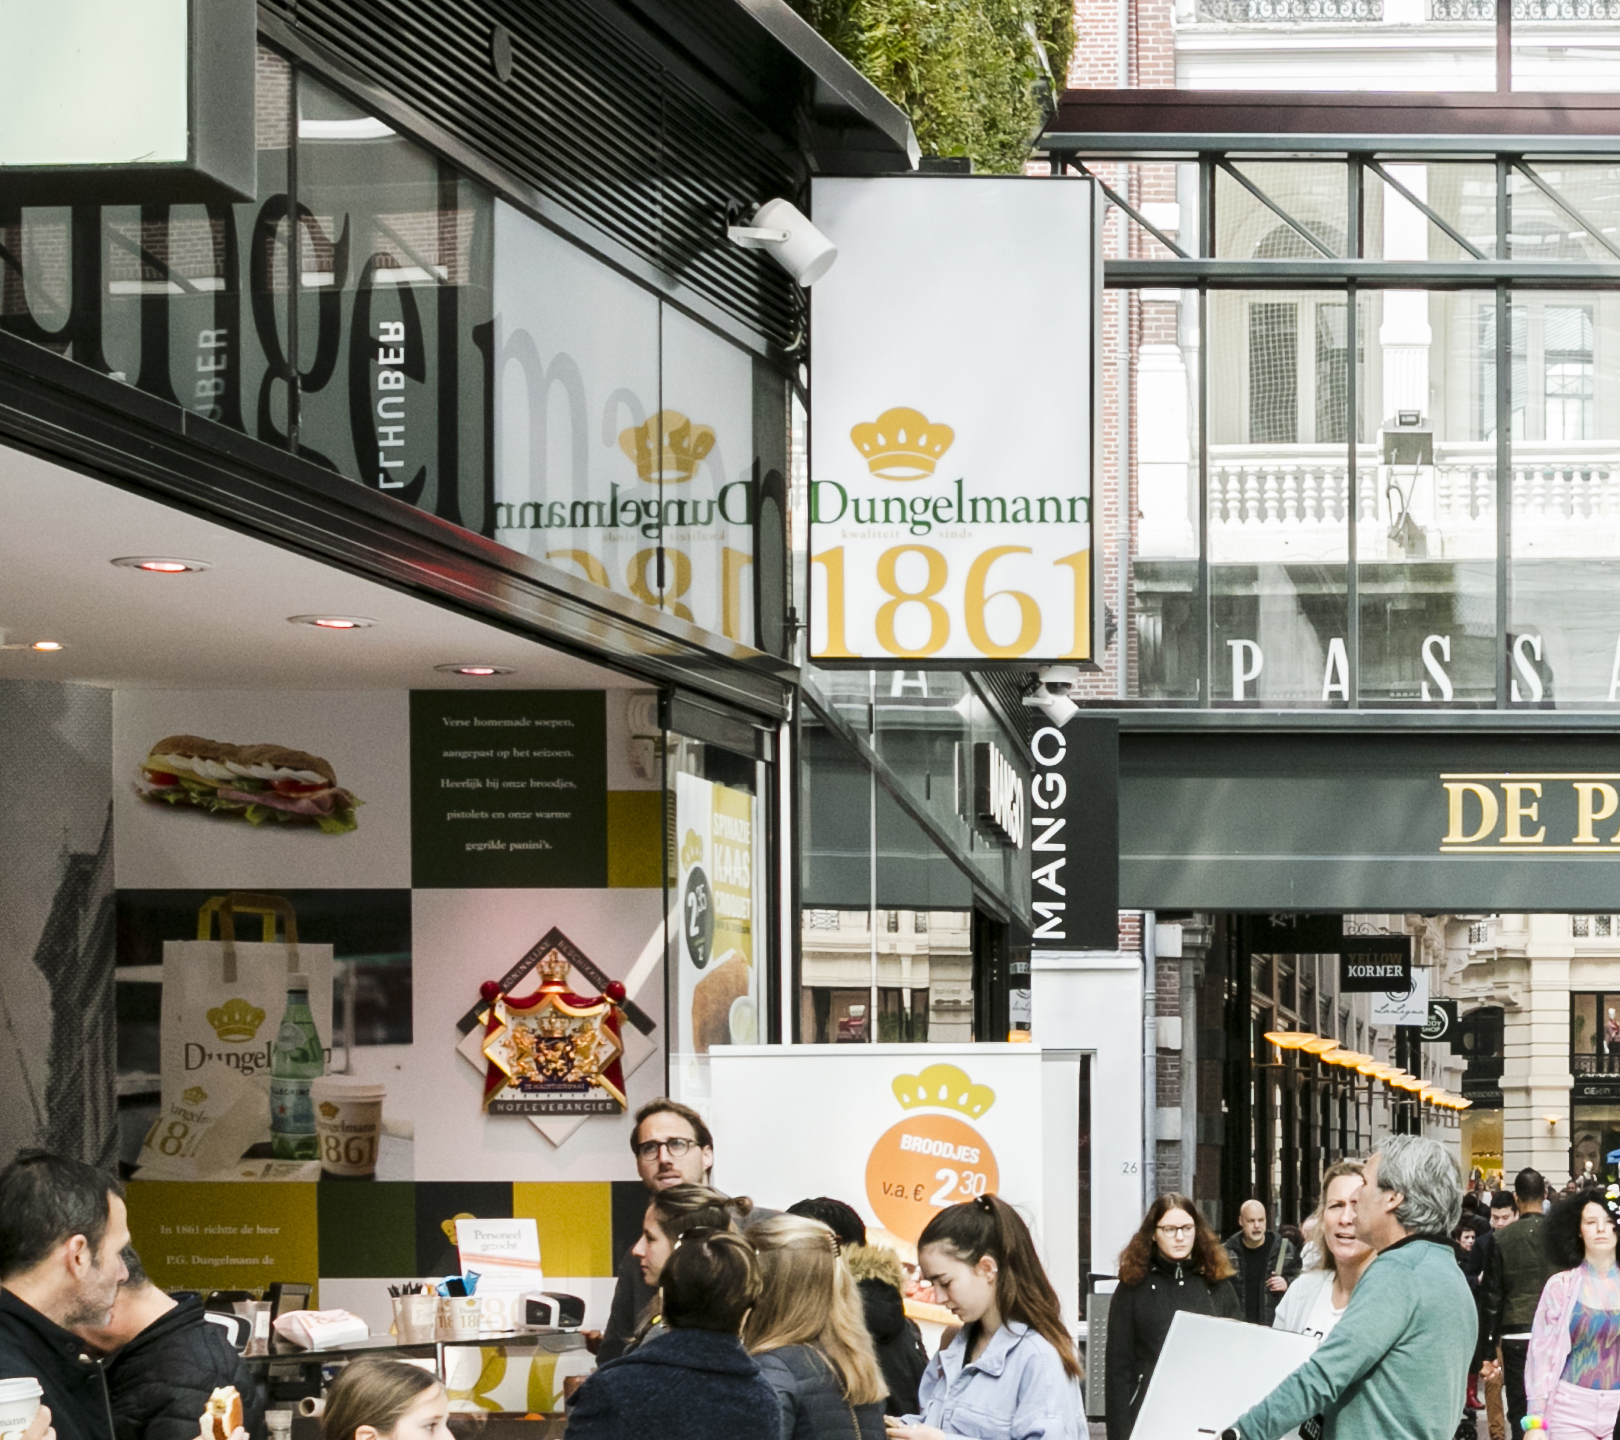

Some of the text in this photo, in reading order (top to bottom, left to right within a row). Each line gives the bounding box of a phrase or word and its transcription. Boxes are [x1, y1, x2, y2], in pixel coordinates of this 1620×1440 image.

[810, 479, 1091, 535] Dungelmann
[810, 543, 1091, 659] 1861
[441, 716, 576, 729] Verse homemade soepen,
[442, 747, 575, 760] aangepast op het seizoen.
[440, 778, 578, 791] Heerlijk bij onze broodjes,
[446, 809, 572, 822] pistolets en onze warme
[1442, 780, 1547, 846] DE
[1031, 725, 1067, 940] MANGO
[465, 839, 553, 852] gegrilde panini's.
[713, 843, 750, 890] KAAS
[1347, 953, 1403, 965] YELLOW
[1347, 964, 1404, 978] KORNER
[496, 1101, 614, 1112] HOFLEVERANCIER
[899, 1133, 981, 1166] BROODJES
[1122, 1161, 1138, 1175] 26
[175, 1224, 201, 1235] 1861
[240, 1224, 255, 1235] de
[256, 1224, 281, 1235] heer
[473, 1229, 522, 1240] Personeel
[481, 1241, 518, 1252] gezocht
[191, 1255, 260, 1267] Dungelmann
[262, 1255, 275, 1266] de
